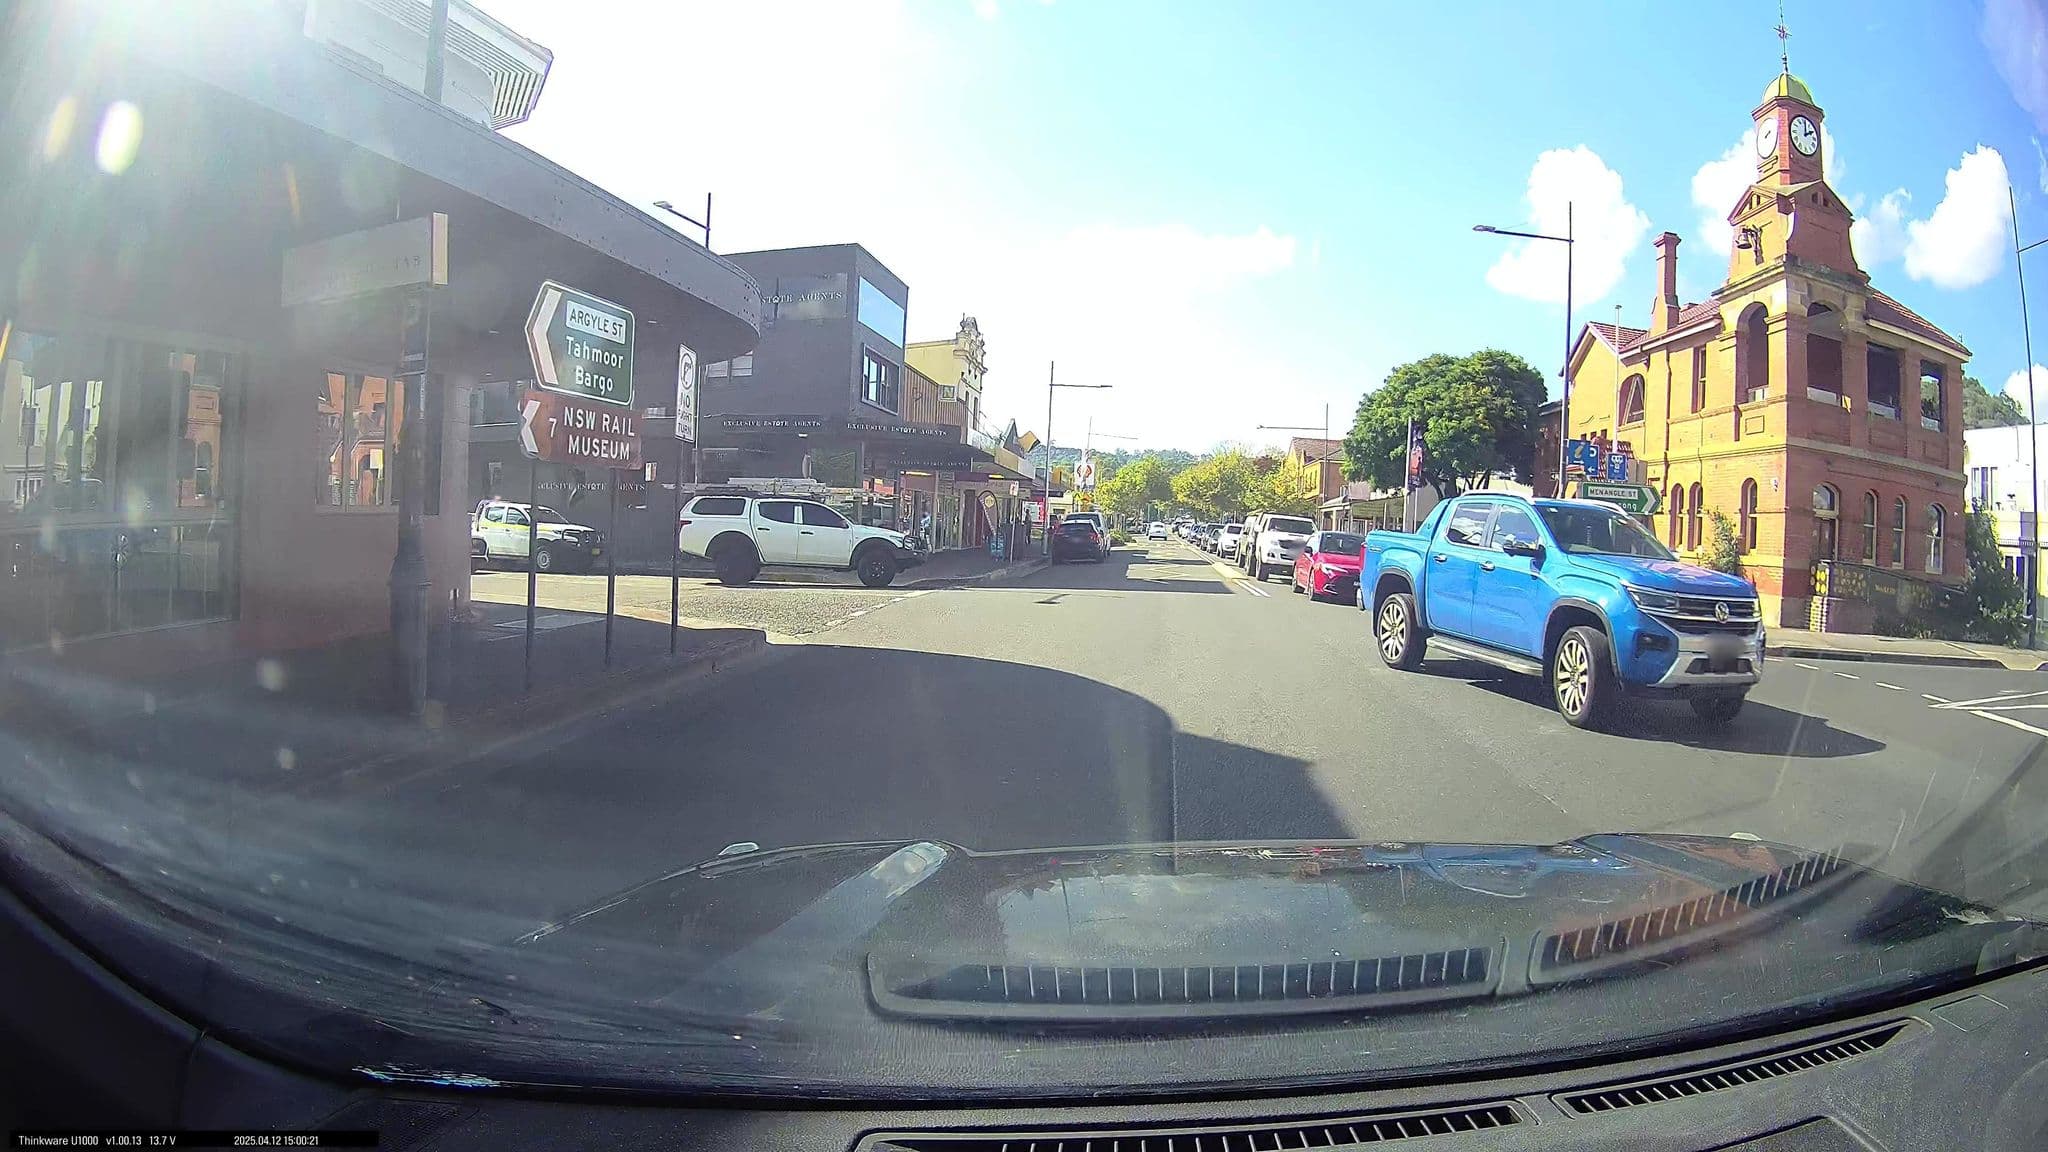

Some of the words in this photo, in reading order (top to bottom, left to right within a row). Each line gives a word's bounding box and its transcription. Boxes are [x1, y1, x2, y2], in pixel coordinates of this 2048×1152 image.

[799, 291, 842, 302] AGENTS
[569, 308, 609, 333] ARGYLE
[612, 321, 623, 338] ST
[566, 335, 624, 369] Tahmoor
[575, 364, 614, 396] Bargo
[548, 417, 557, 438] 7
[564, 406, 596, 430] NSW
[602, 413, 635, 437] RAIL
[568, 434, 630, 461] MUSEUM
[1590, 487, 1625, 497] MENANGLE
[1629, 489, 1637, 498] ST
